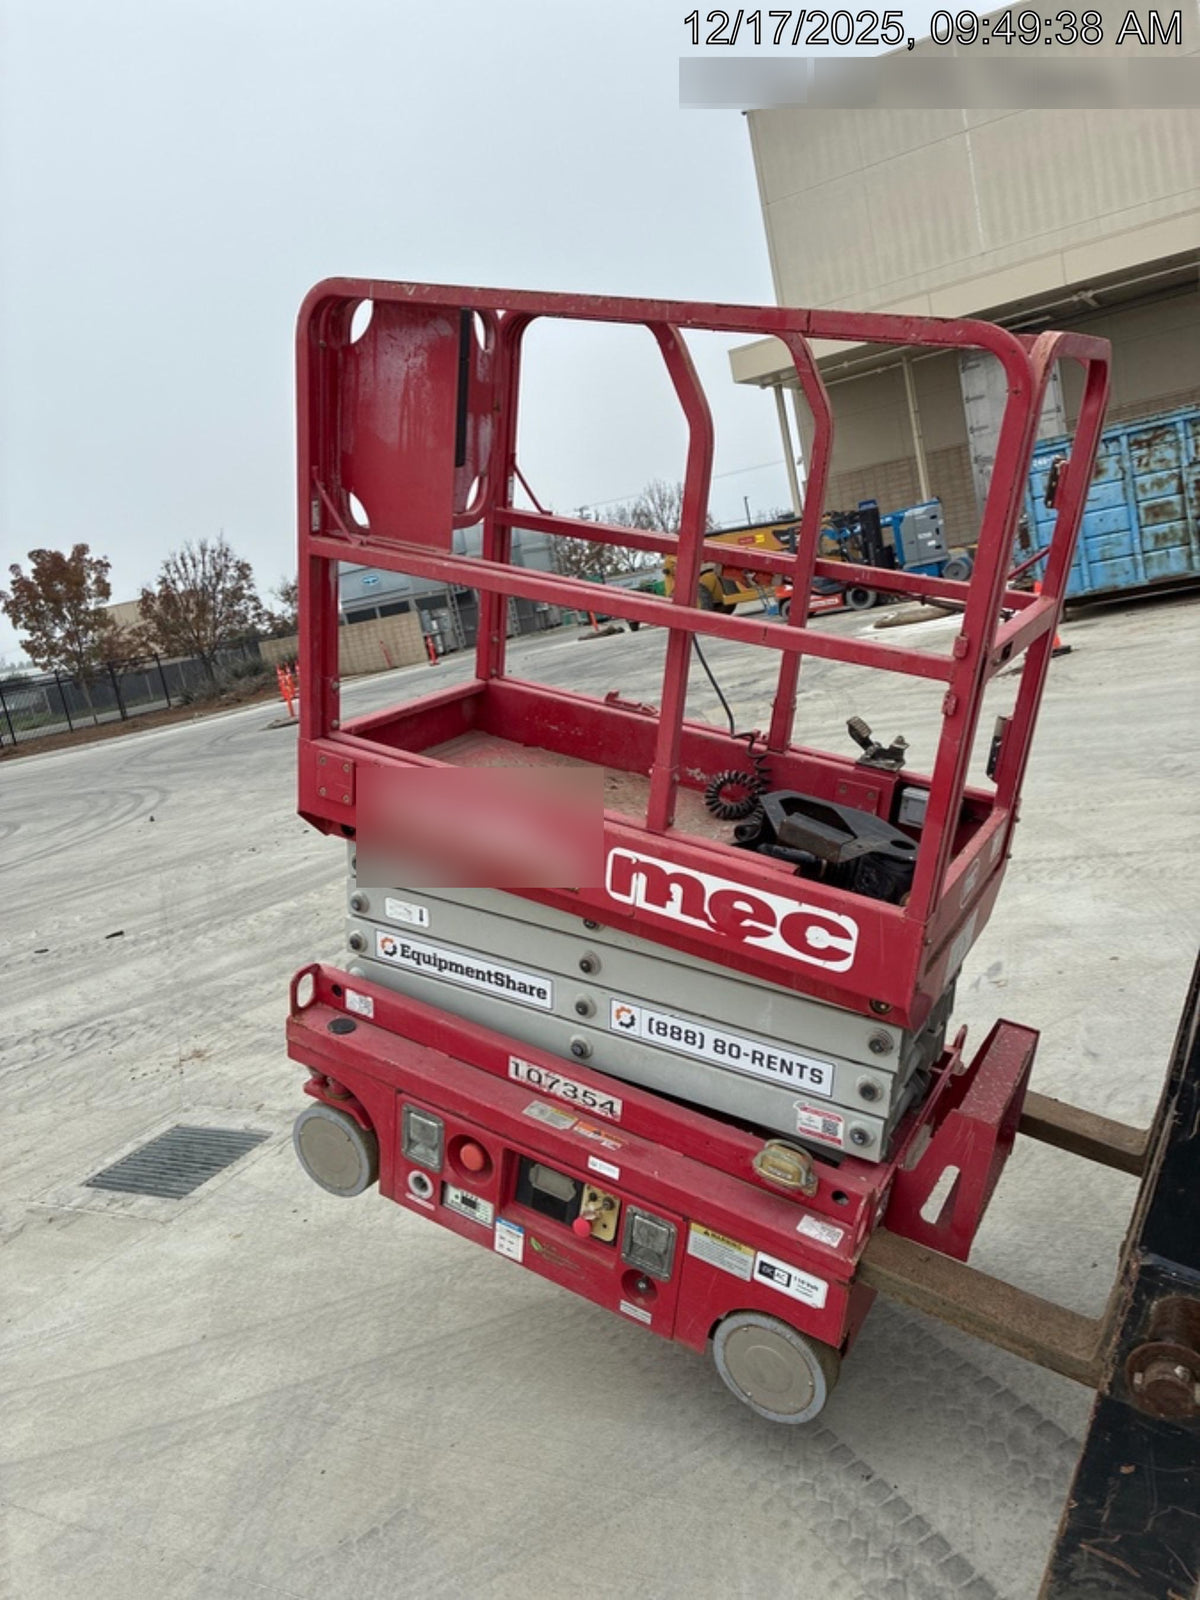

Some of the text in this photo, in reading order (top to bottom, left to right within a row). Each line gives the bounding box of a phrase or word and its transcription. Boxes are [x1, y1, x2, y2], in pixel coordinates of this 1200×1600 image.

[611, 853, 853, 963] mec
[400, 943, 547, 1000] EquipmentShare
[648, 1017, 823, 1085] (888) 80-RENTS
[511, 1060, 617, 1117] 107354
